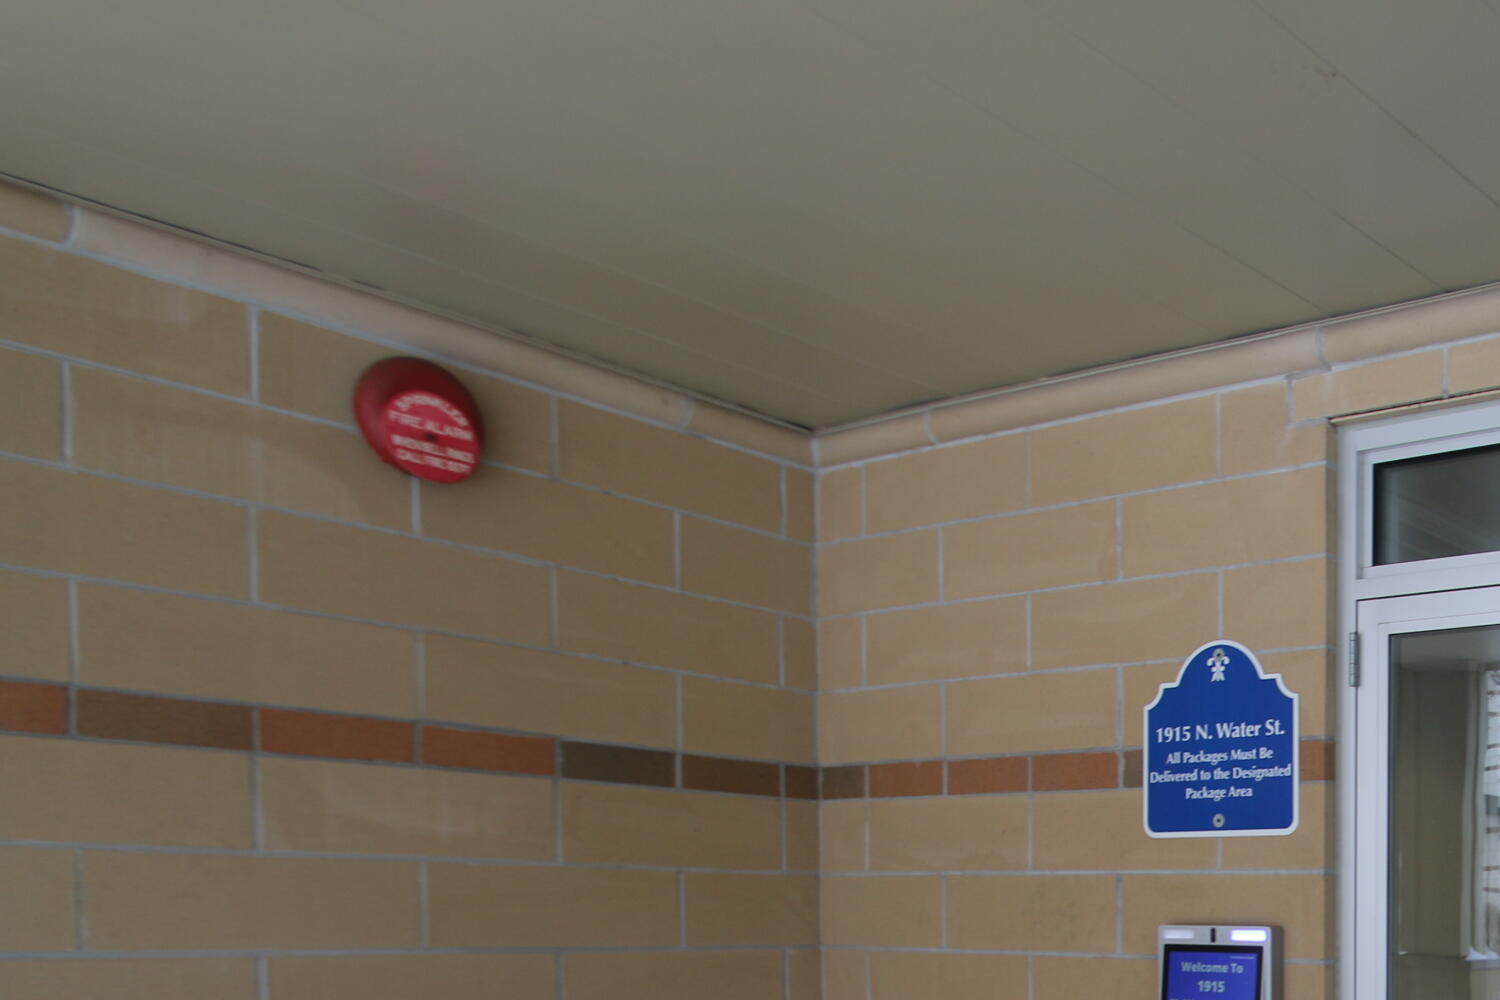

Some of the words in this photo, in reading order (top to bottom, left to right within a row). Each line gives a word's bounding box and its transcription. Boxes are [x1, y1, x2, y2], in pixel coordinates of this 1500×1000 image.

[1156, 726, 1191, 743] 1915
[1195, 724, 1213, 740] N.
[1216, 722, 1262, 739] Water
[1265, 718, 1285, 736] St.
[1167, 752, 1181, 764] All
[1183, 751, 1228, 766] Packages
[1230, 749, 1257, 760] Must
[1259, 747, 1274, 759] Be
[1150, 769, 1198, 783] Delivered
[1200, 769, 1211, 781] to
[1213, 767, 1230, 780] the
[1232, 763, 1292, 782] Designated
[1186, 786, 1226, 801] Package
[1228, 786, 1253, 798] Area
[1181, 962, 1228, 973] Welcome
[1230, 963, 1244, 974] To
[1198, 980, 1225, 992] 1915
